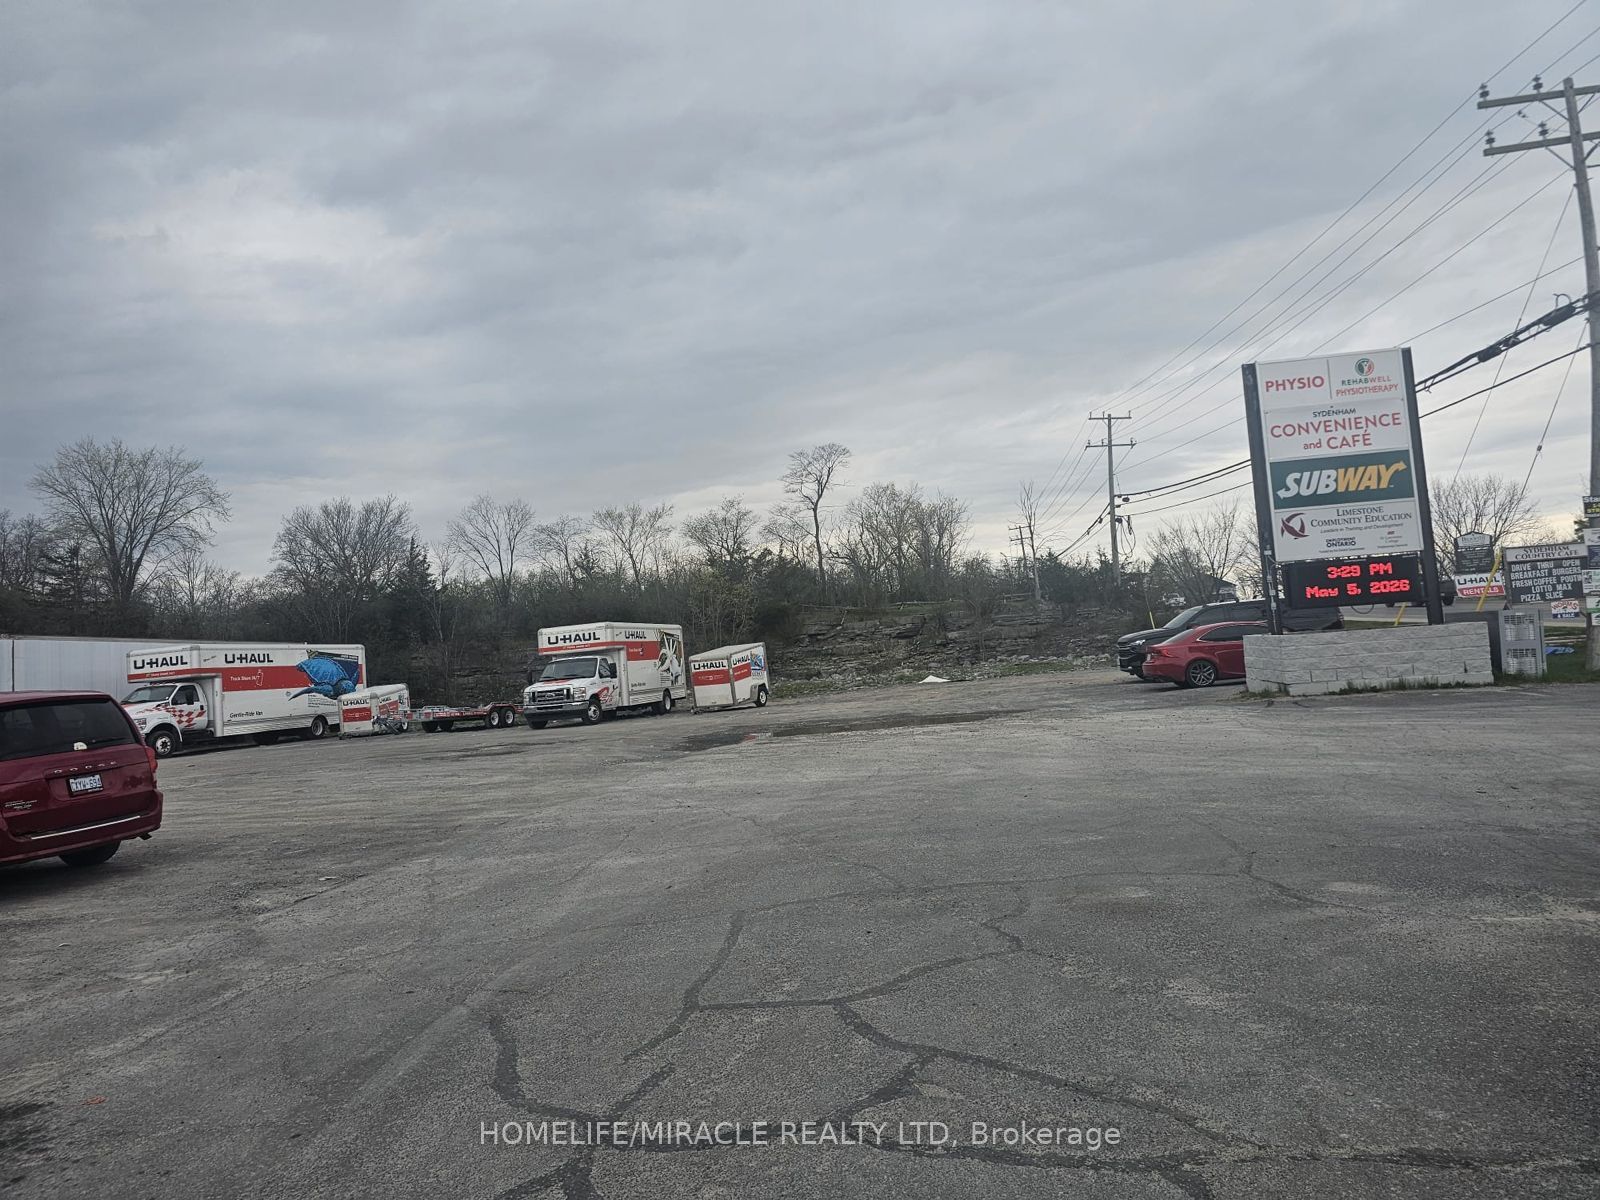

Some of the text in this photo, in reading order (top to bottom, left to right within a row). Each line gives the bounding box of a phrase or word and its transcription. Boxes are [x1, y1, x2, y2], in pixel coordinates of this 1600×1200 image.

[1265, 376, 1325, 392] PHYSIO
[1341, 376, 1392, 386] REHABWELL
[1336, 384, 1399, 397] PHYSIOTHERAPY
[1312, 408, 1357, 418] SYDENHAM
[1270, 412, 1402, 438] CONVENIENCE
[1303, 429, 1372, 450] and CAFÉ
[1276, 461, 1407, 499] SUBWAY
[1515, 552, 1556, 560] COUNTRY
[1327, 562, 1393, 579] 3:29 PM
[1511, 559, 1580, 572] DRIVE THRU OPEN
[1510, 566, 1581, 580] BREAKFAST BURGERS
[1305, 579, 1411, 598] May 5, 2026
[1512, 579, 1533, 588] FRESH
[1533, 577, 1557, 586] COFFEE
[1531, 583, 1573, 594] LOTTO MAX
[1520, 591, 1564, 602] PIZZA SLICE
[1551, 600, 1579, 610] WORMS
[547, 631, 601, 645] U-HAUL
[624, 630, 647, 640] U-HAUL
[133, 655, 188, 670] U-HAUL
[224, 653, 274, 664] U-HAUL
[693, 661, 726, 670] U-HAUL
